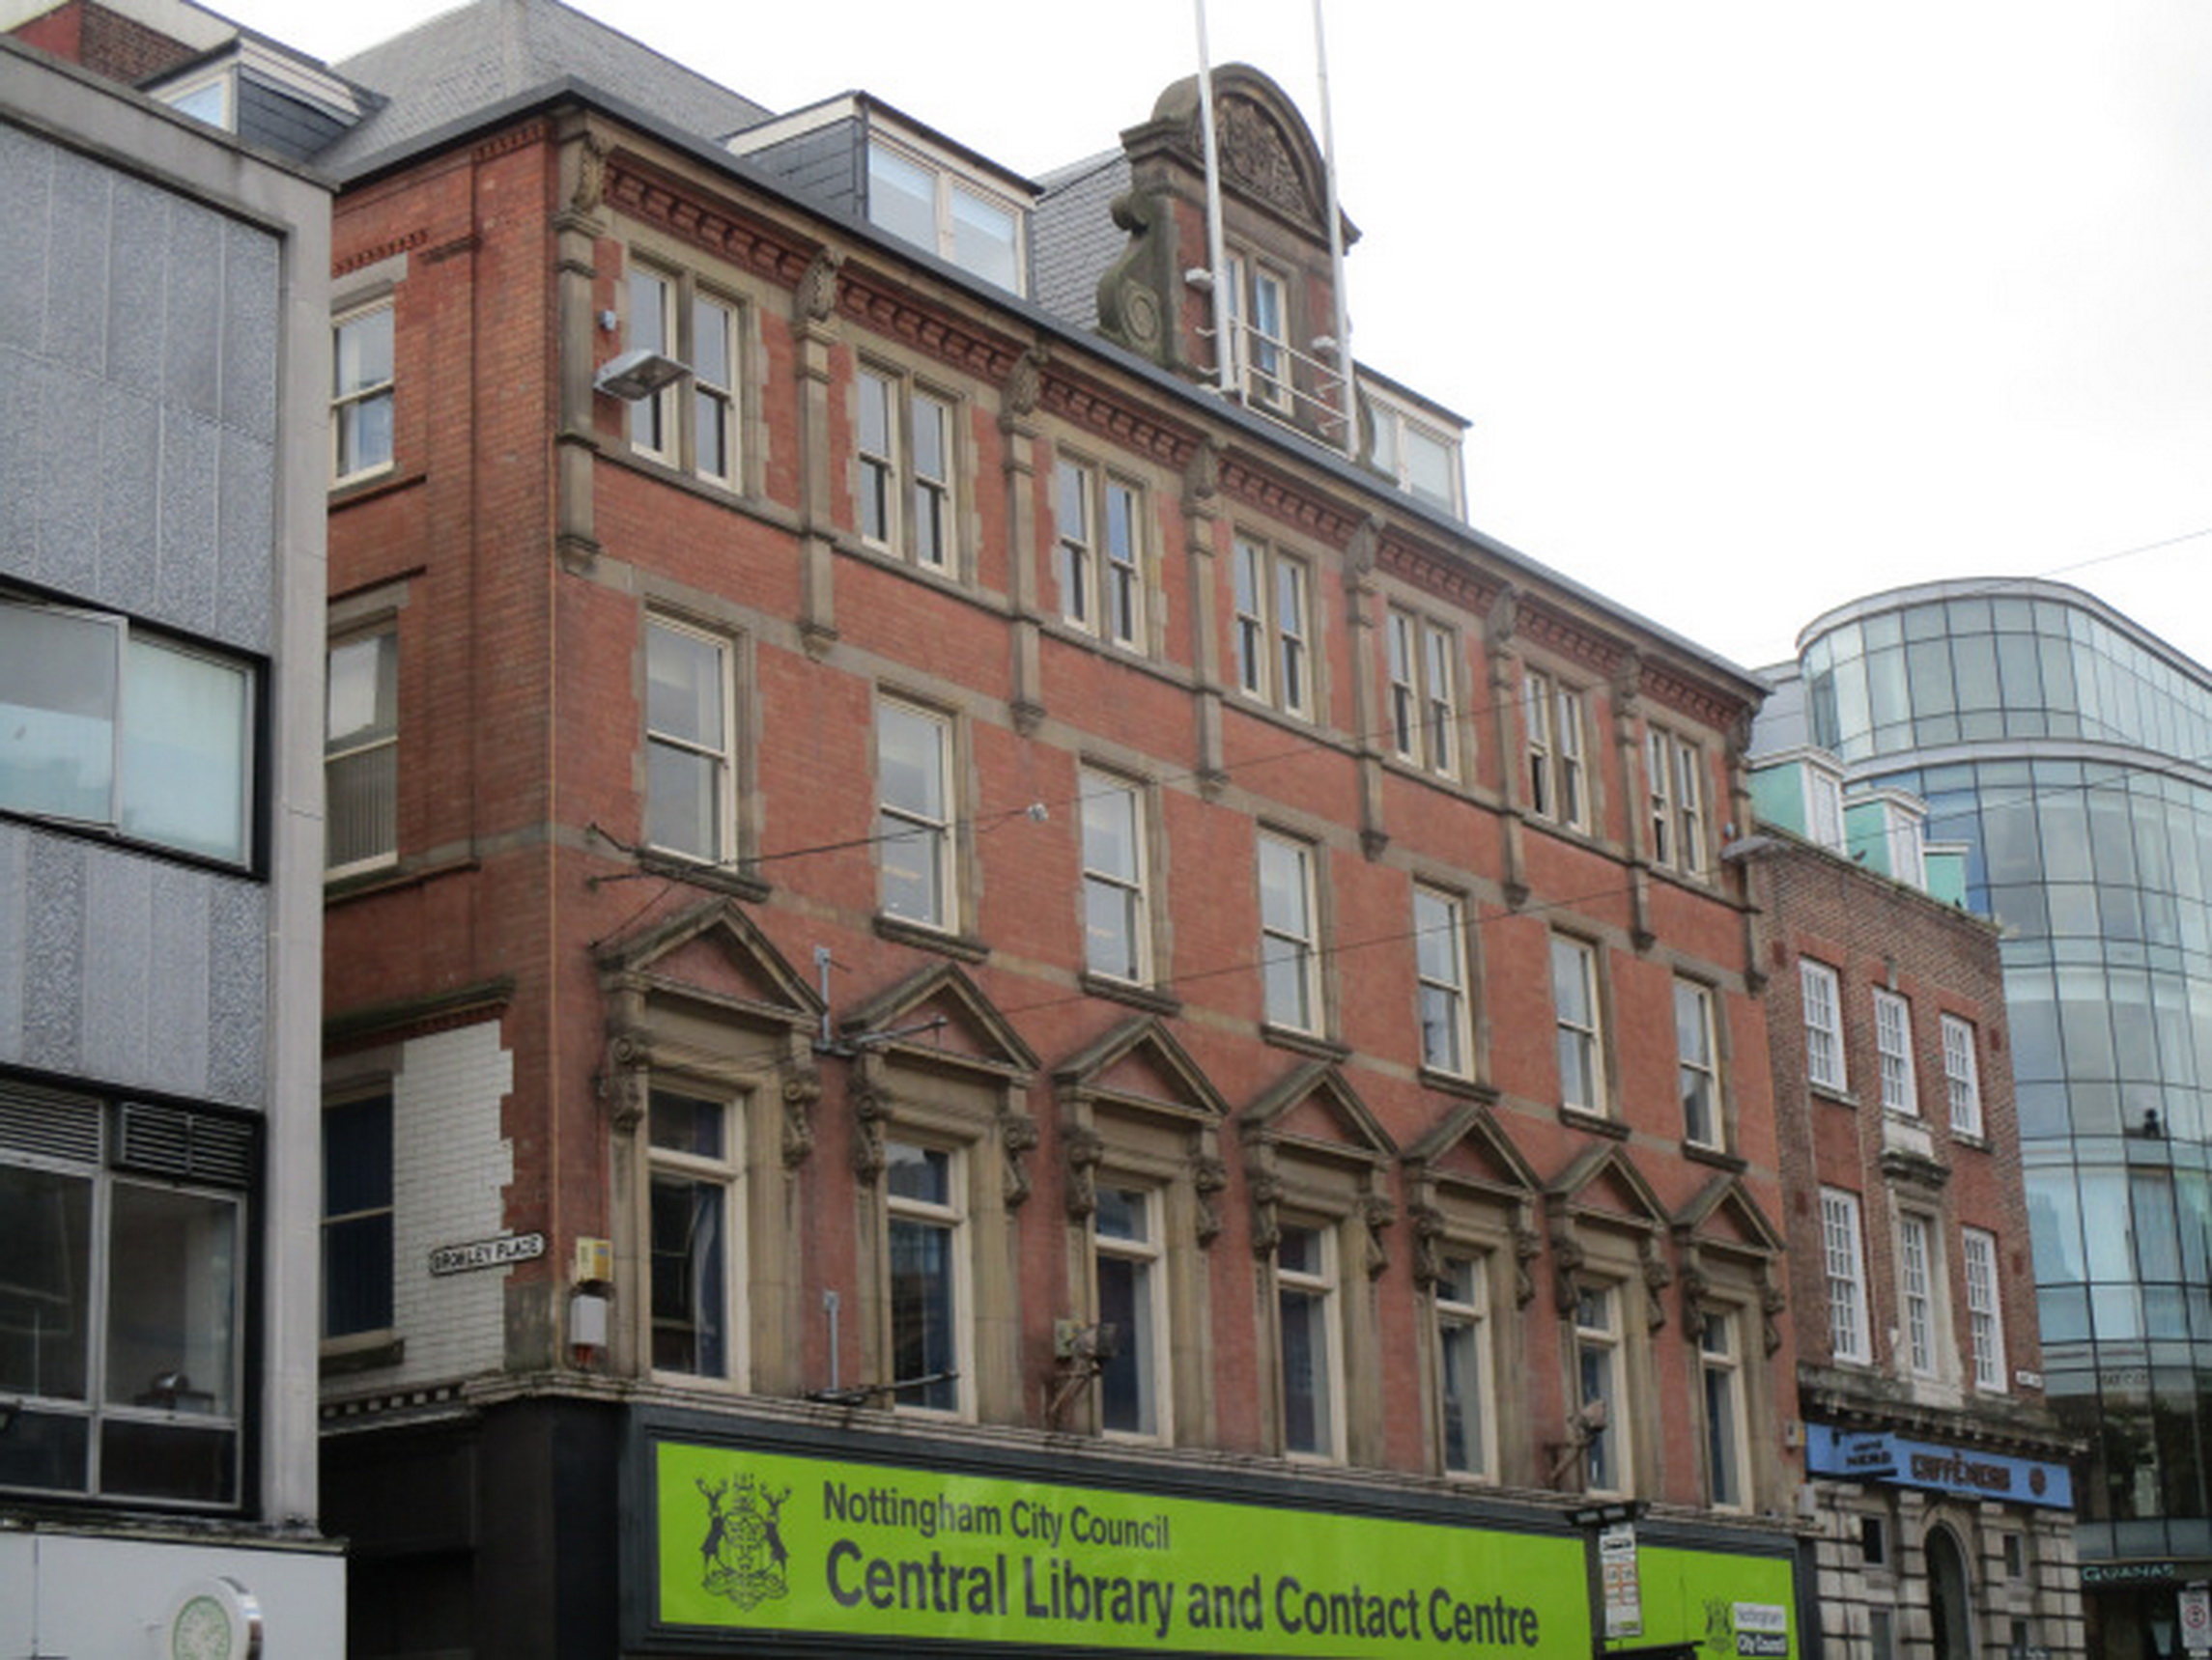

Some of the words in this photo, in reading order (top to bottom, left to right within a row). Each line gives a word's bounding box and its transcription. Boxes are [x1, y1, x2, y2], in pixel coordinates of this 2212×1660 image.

[496, 1235, 539, 1259] PLACE
[825, 1479, 1003, 1539] Nottingham
[1010, 1499, 1063, 1549] City
[1070, 1505, 1170, 1550] Council
[826, 1538, 1008, 1617] Central
[1023, 1556, 1175, 1641] Library
[1187, 1574, 1264, 1632] and
[1274, 1575, 1422, 1642] Contact
[1428, 1587, 1539, 1646] Centre
